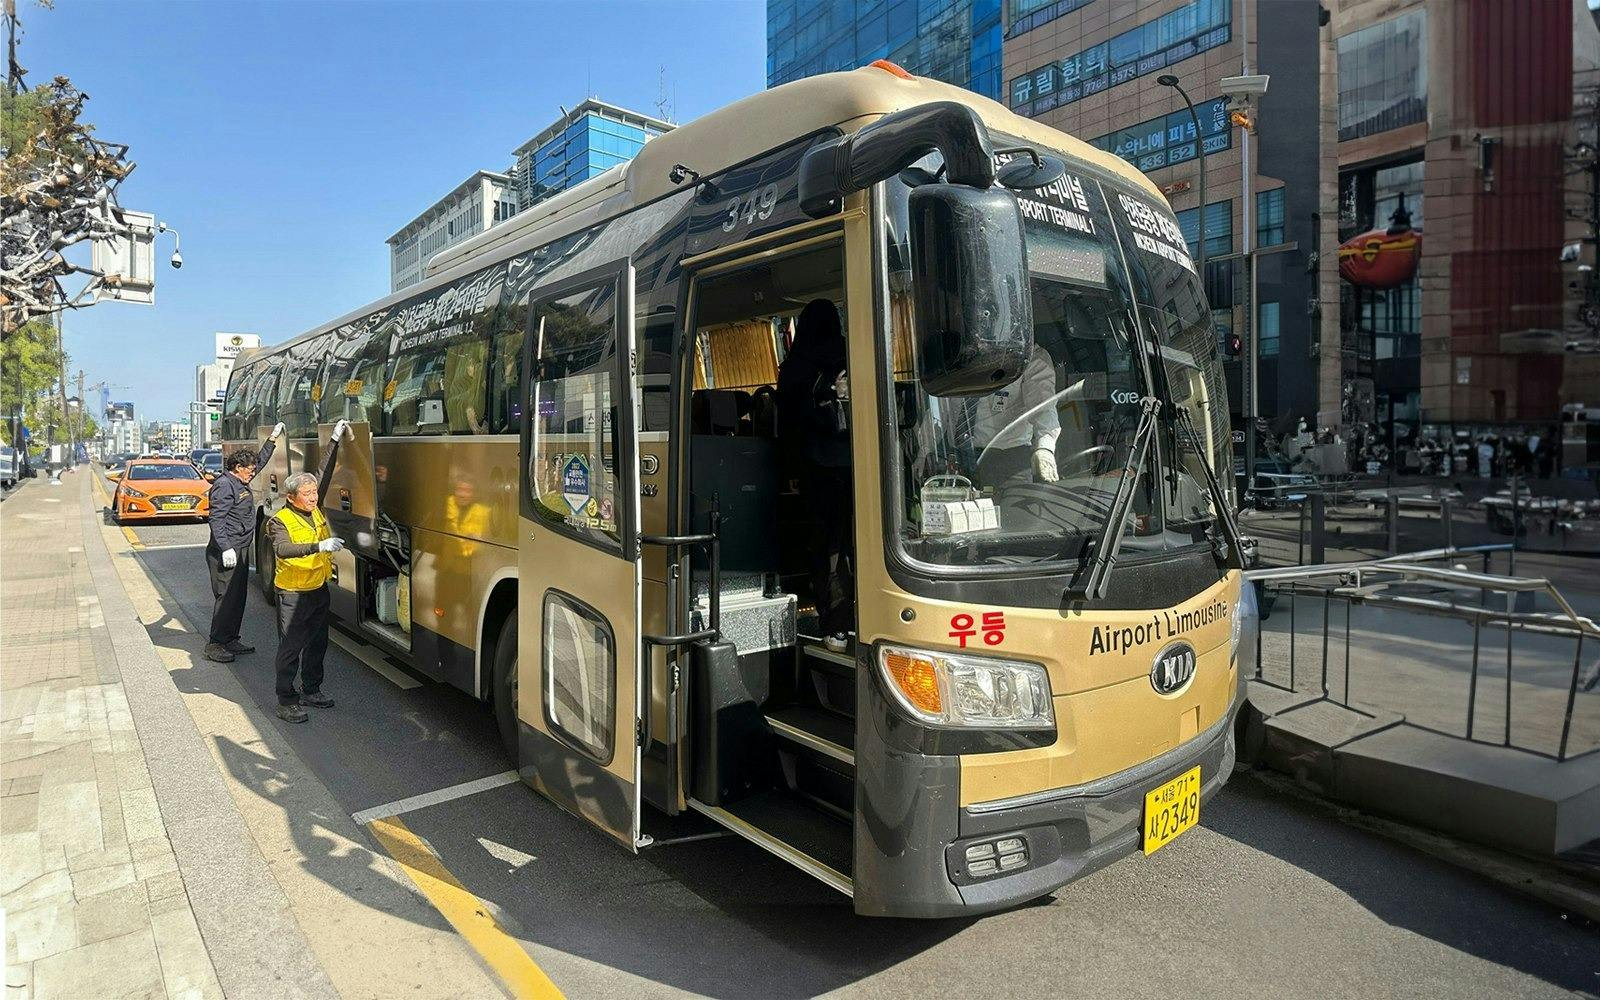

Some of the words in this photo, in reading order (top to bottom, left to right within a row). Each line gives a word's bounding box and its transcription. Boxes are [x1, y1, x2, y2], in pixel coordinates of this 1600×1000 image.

[1202, 136, 1227, 151] SKIN
[722, 183, 778, 232] 349
[1017, 197, 1049, 222] RPORT
[1047, 205, 1092, 234] TERMINAL
[1088, 218, 1096, 235] 1
[418, 330, 439, 345] AIRPORT
[439, 324, 464, 339] TERMINAL
[1110, 389, 1140, 404] Kore
[949, 611, 1006, 648] 우등
[1089, 615, 1161, 655] Airport
[1167, 599, 1228, 637] Limousine
[1162, 651, 1195, 692] KIA
